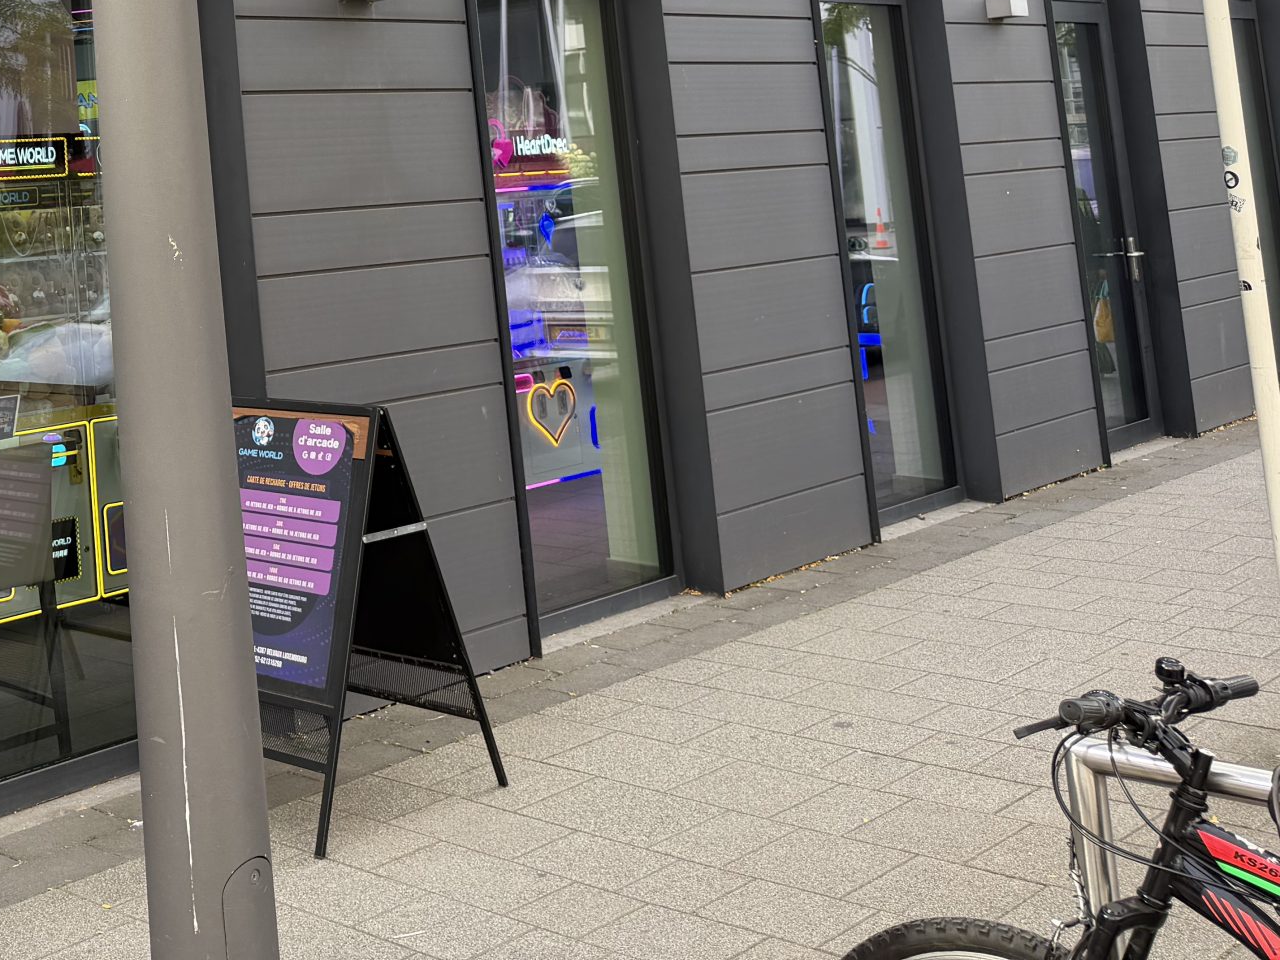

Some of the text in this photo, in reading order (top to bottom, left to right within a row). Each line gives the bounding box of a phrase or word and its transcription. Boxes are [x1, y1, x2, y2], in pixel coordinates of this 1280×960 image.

[16, 146, 57, 164] WORLD
[309, 424, 332, 435] Salle
[298, 435, 339, 448] d'arcade
[238, 448, 283, 460] GAME WORLD
[1233, 850, 1280, 878] KS26
